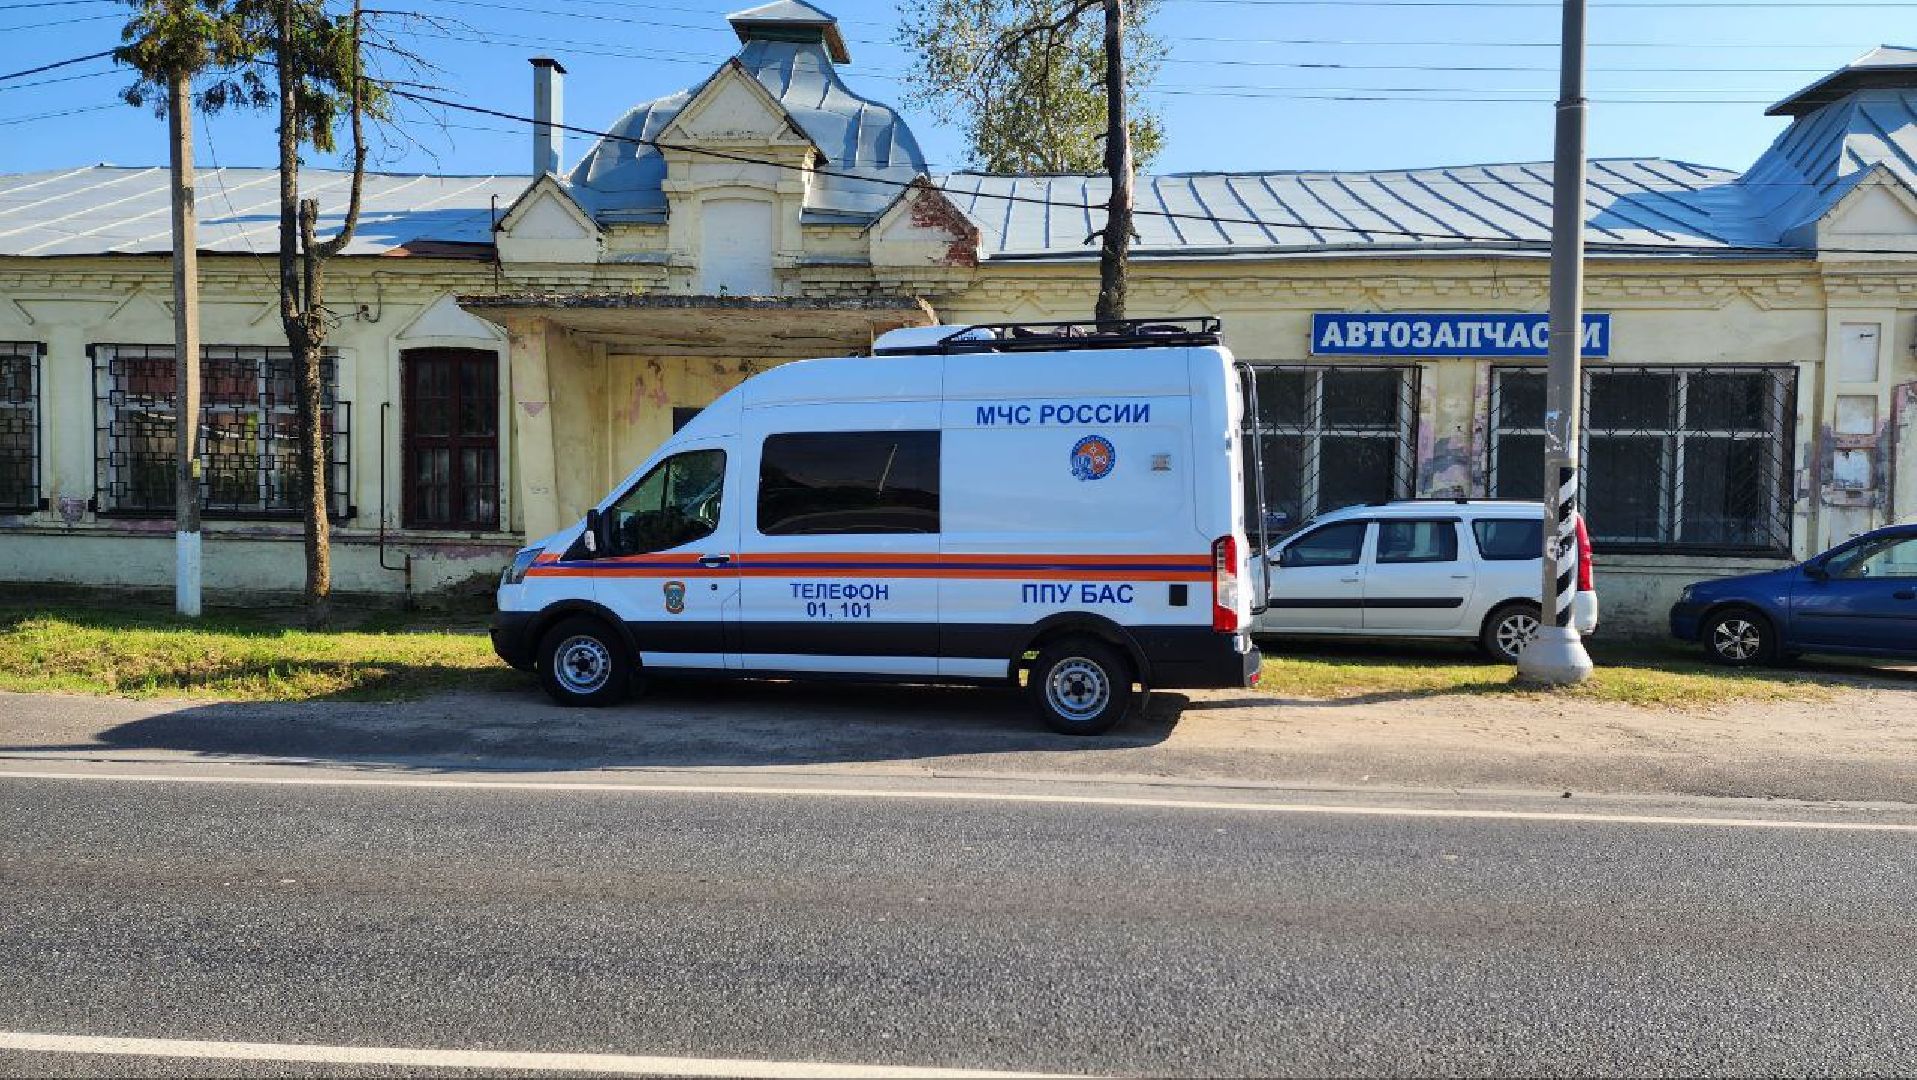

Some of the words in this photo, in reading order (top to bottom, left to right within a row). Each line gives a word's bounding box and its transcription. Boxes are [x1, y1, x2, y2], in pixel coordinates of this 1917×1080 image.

[1320, 321, 1602, 349] АВТОЗАПЧАСИ
[976, 406, 1031, 425] МЧС
[1039, 404, 1150, 424] РОССИИ
[790, 583, 889, 600] ТЕЛЕФОН
[1022, 583, 1073, 604] ППУ
[1081, 583, 1134, 604] БАС
[807, 602, 833, 620] 01,
[840, 602, 872, 618] 101
